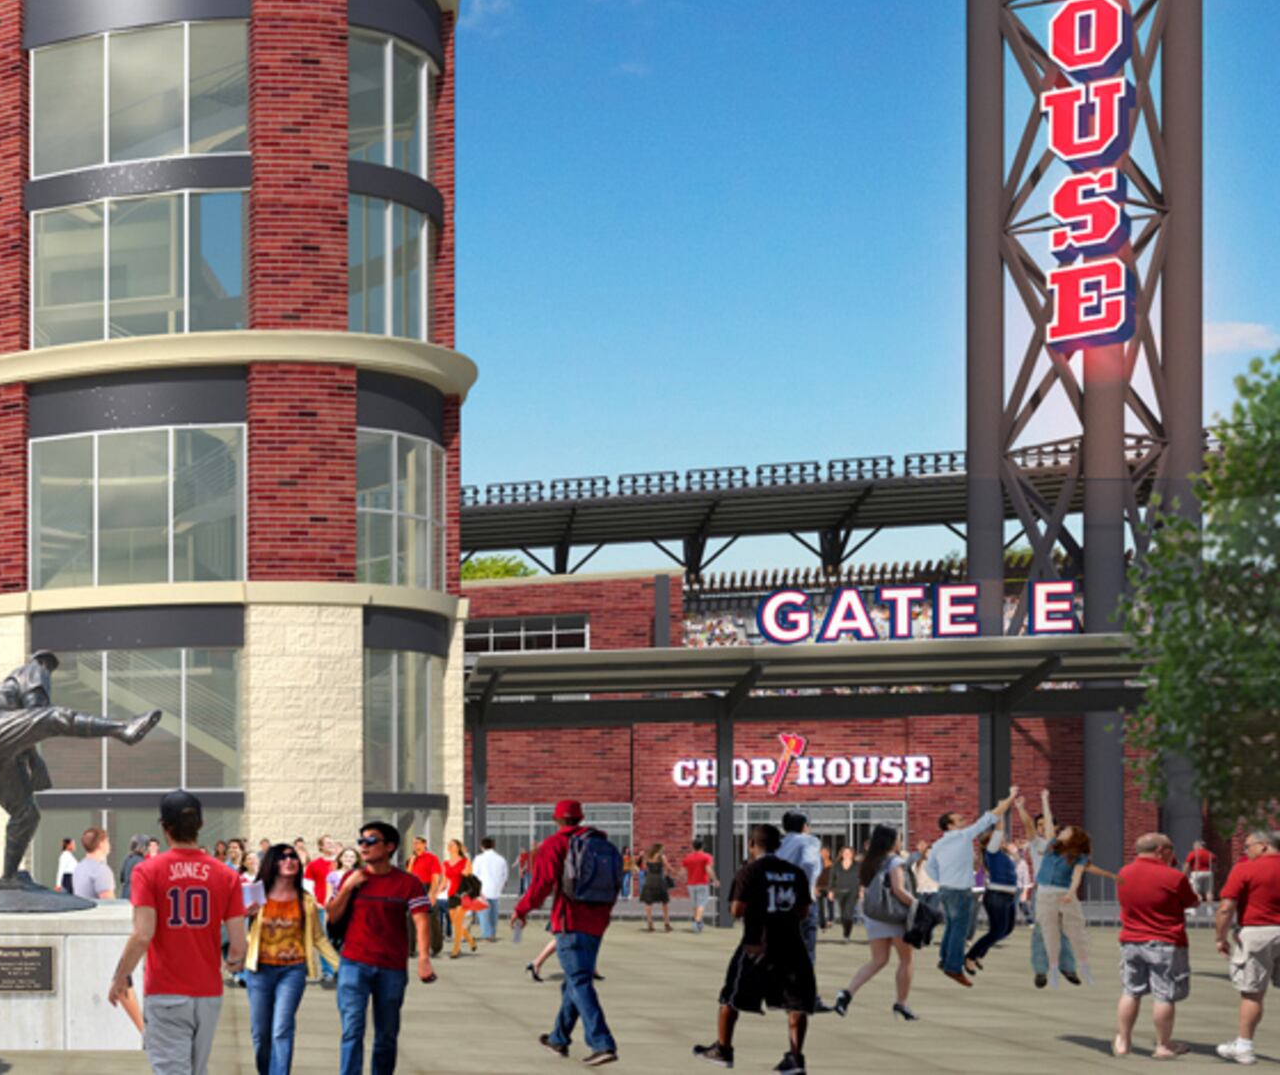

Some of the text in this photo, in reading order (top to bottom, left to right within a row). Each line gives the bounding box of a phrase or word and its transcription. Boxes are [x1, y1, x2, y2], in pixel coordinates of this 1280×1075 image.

[757, 579, 1076, 644] GATE E
[672, 755, 934, 787] CHOP HOUSE
[168, 861, 211, 881] JONES
[167, 886, 210, 928] 10
